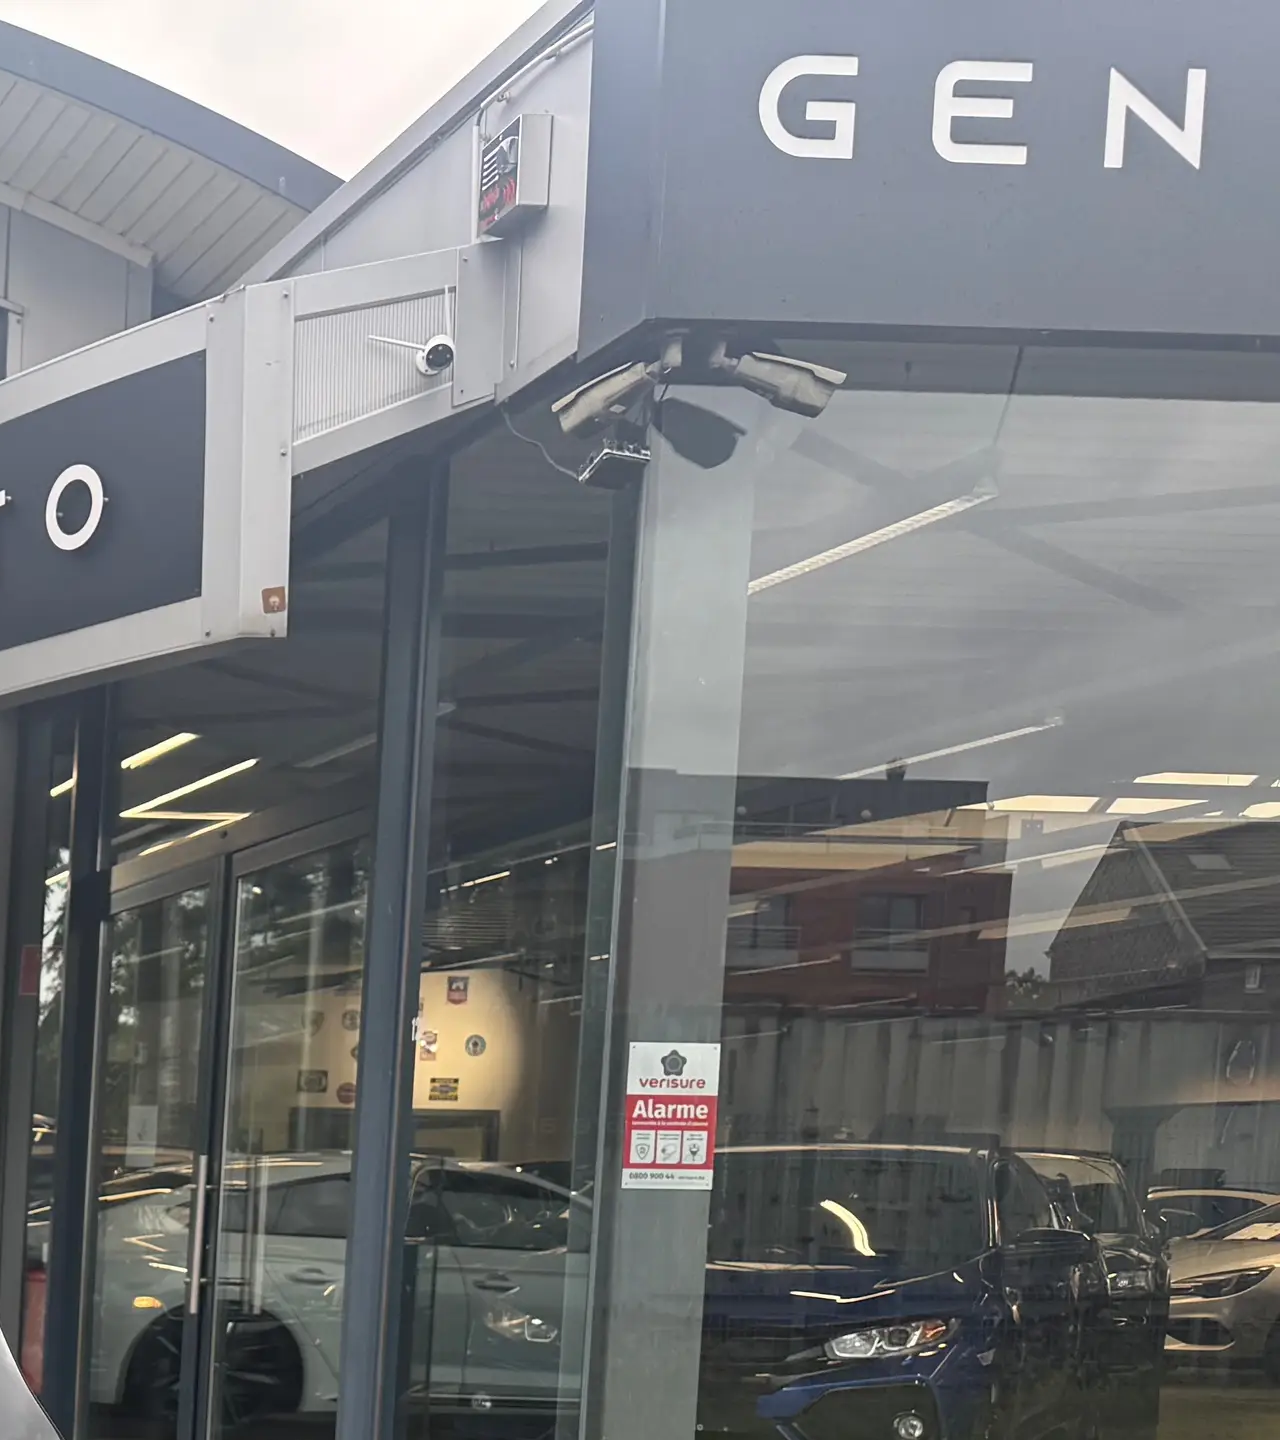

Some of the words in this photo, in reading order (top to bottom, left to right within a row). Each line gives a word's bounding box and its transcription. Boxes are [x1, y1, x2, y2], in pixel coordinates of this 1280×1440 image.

[757, 54, 1207, 170] GEN
[639, 1077, 706, 1089] verisure
[632, 1098, 709, 1119] Alarme
